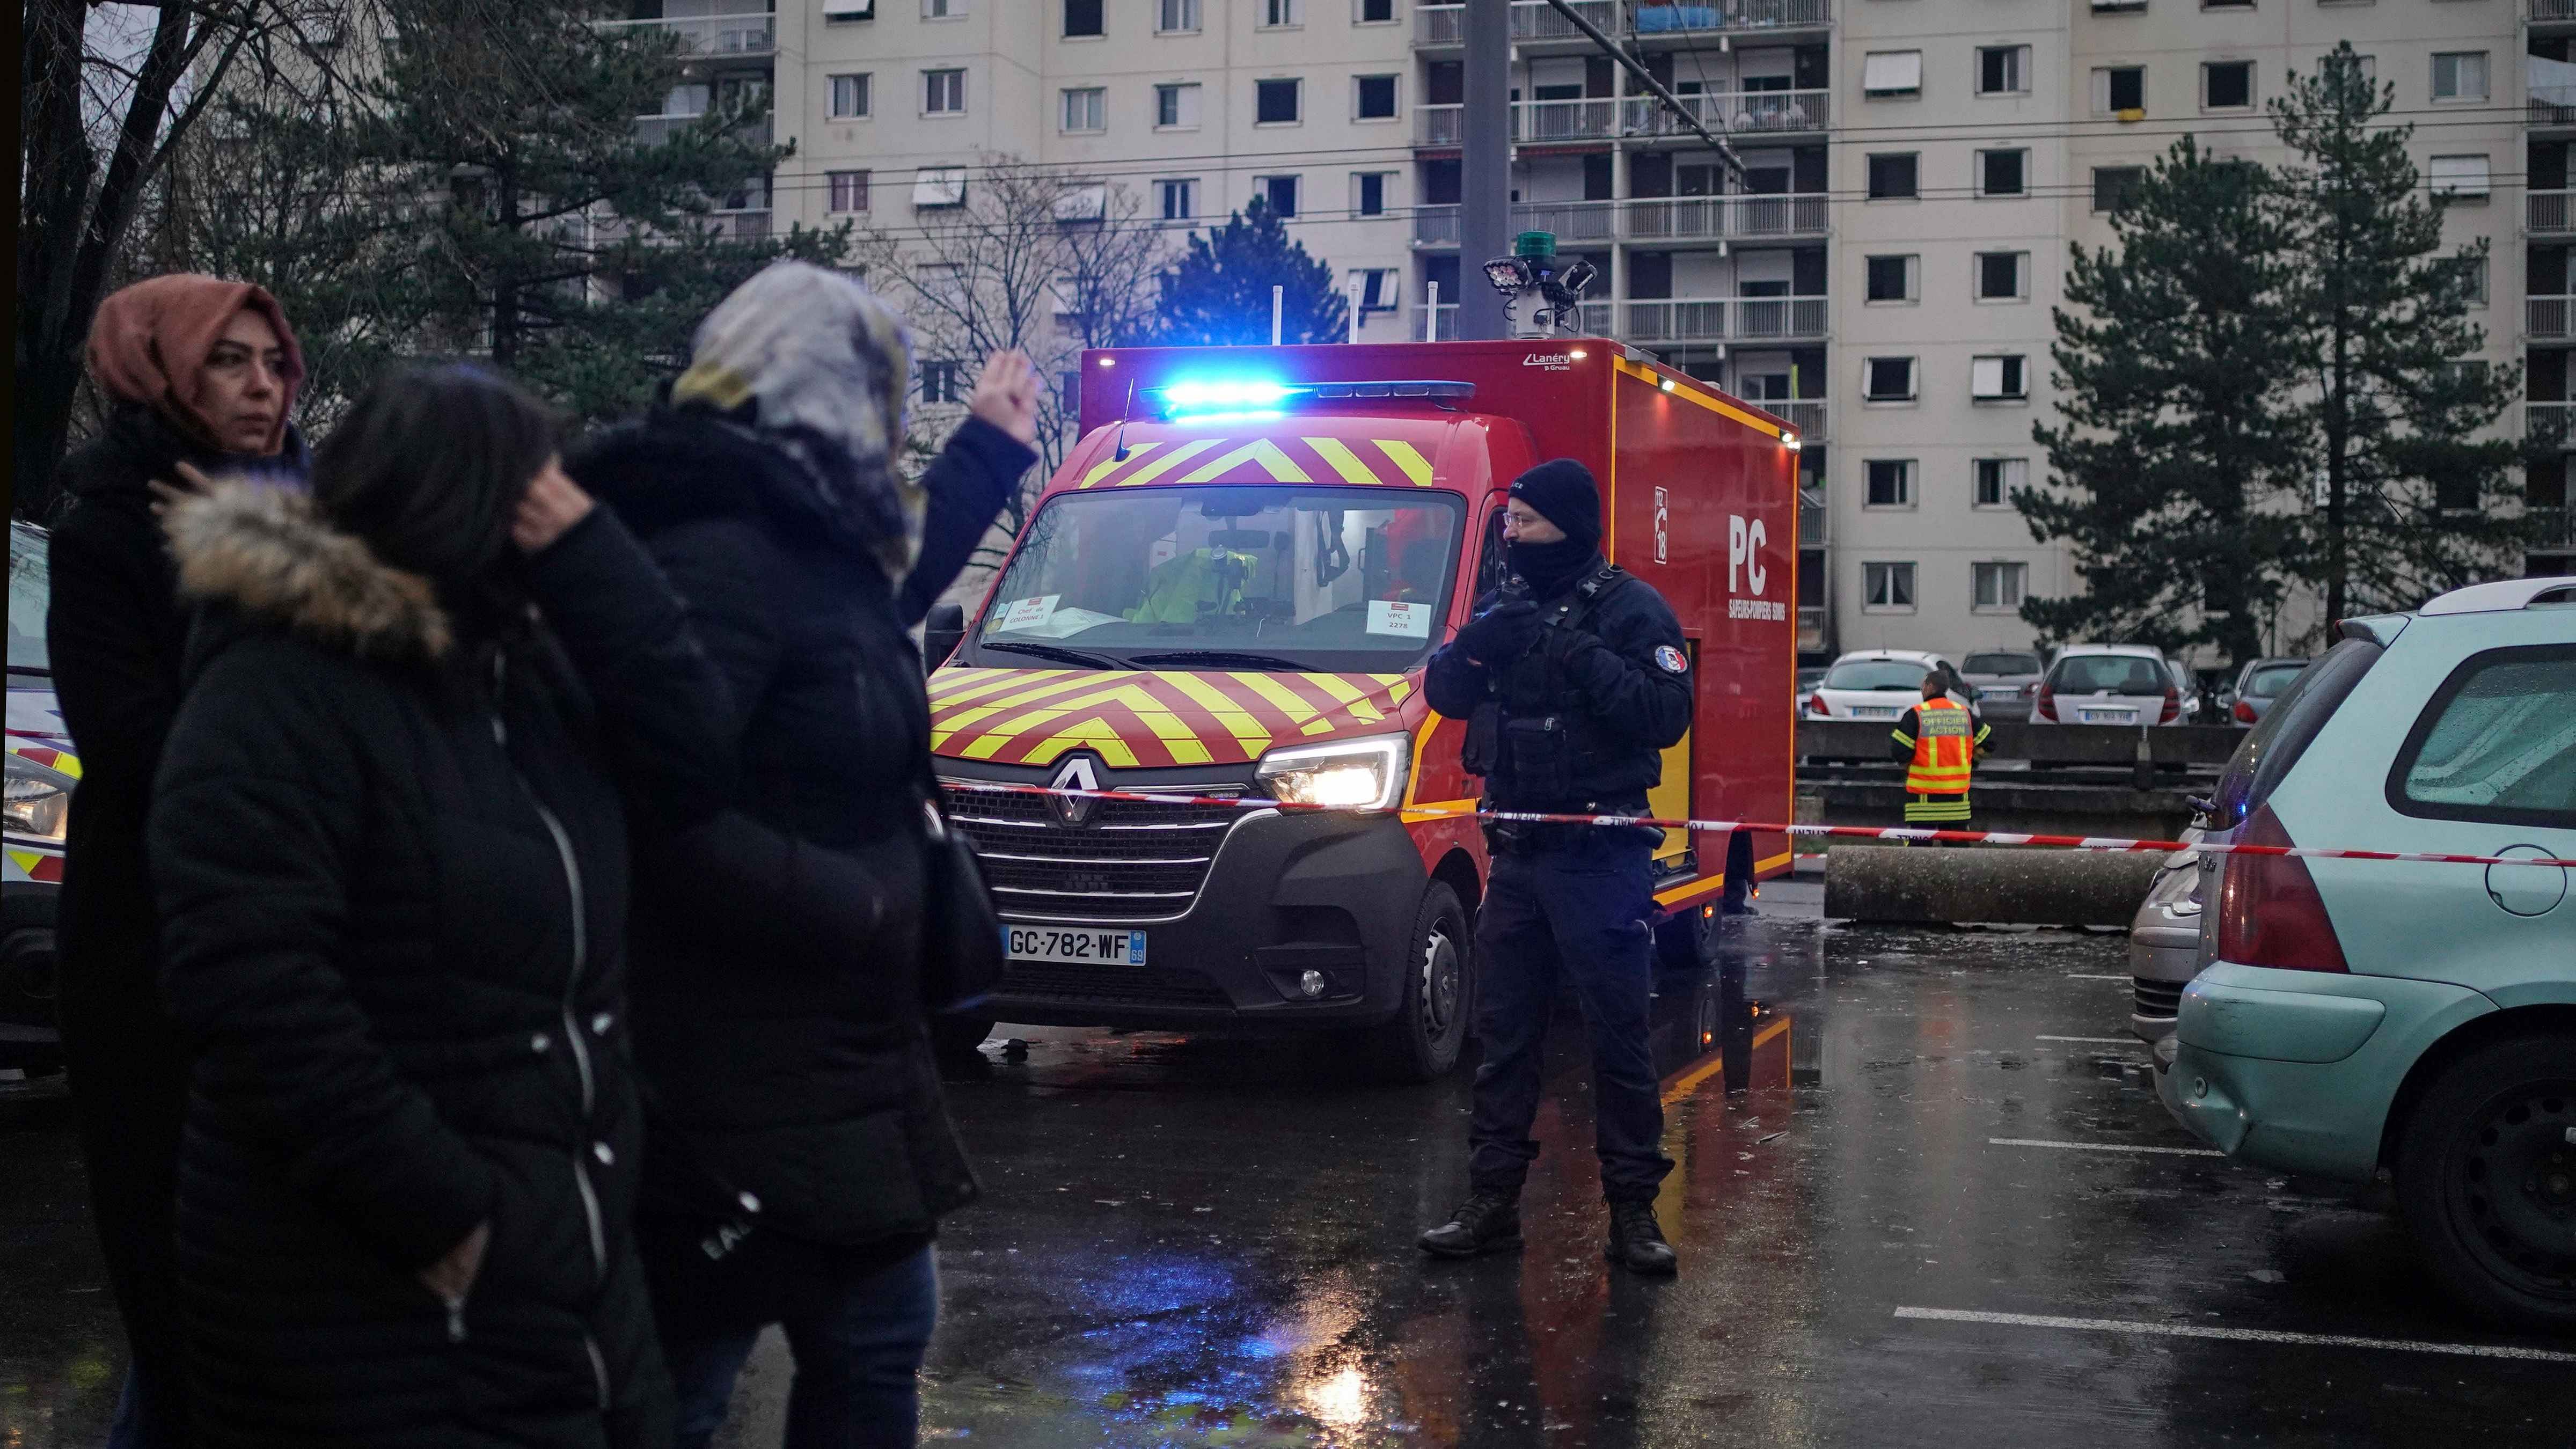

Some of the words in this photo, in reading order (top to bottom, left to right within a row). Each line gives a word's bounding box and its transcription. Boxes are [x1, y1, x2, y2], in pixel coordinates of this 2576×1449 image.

[1533, 353, 1570, 364] Lanéry
[1657, 529, 1666, 560] 18
[1729, 514, 1767, 596] PC
[1009, 615, 1039, 624] COLONNE
[1009, 930, 1129, 959] GC-782-WF
[1131, 949, 1144, 961] 69
